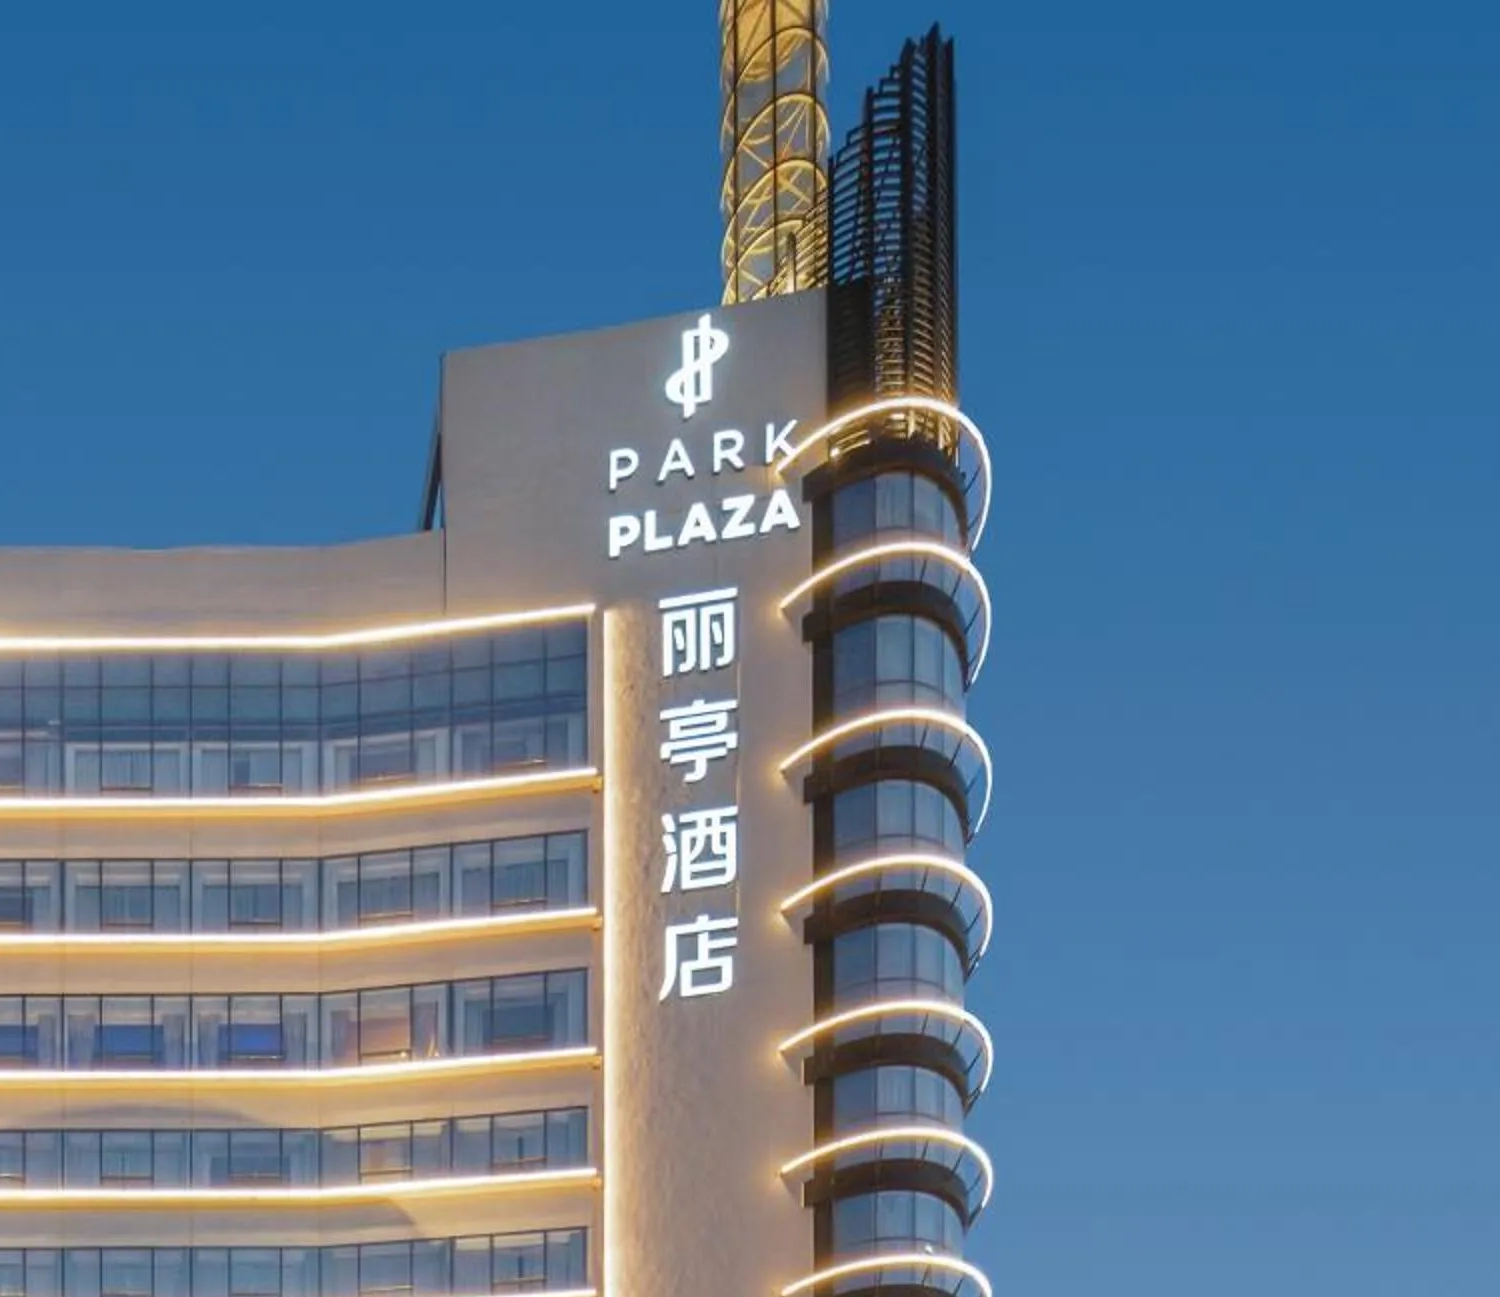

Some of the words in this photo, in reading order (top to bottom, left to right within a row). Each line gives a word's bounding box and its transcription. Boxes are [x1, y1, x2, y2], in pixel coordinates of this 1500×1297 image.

[608, 419, 798, 488] PARK
[608, 489, 800, 557] PLAZA
[659, 587, 739, 1001] 丽亭酒店
